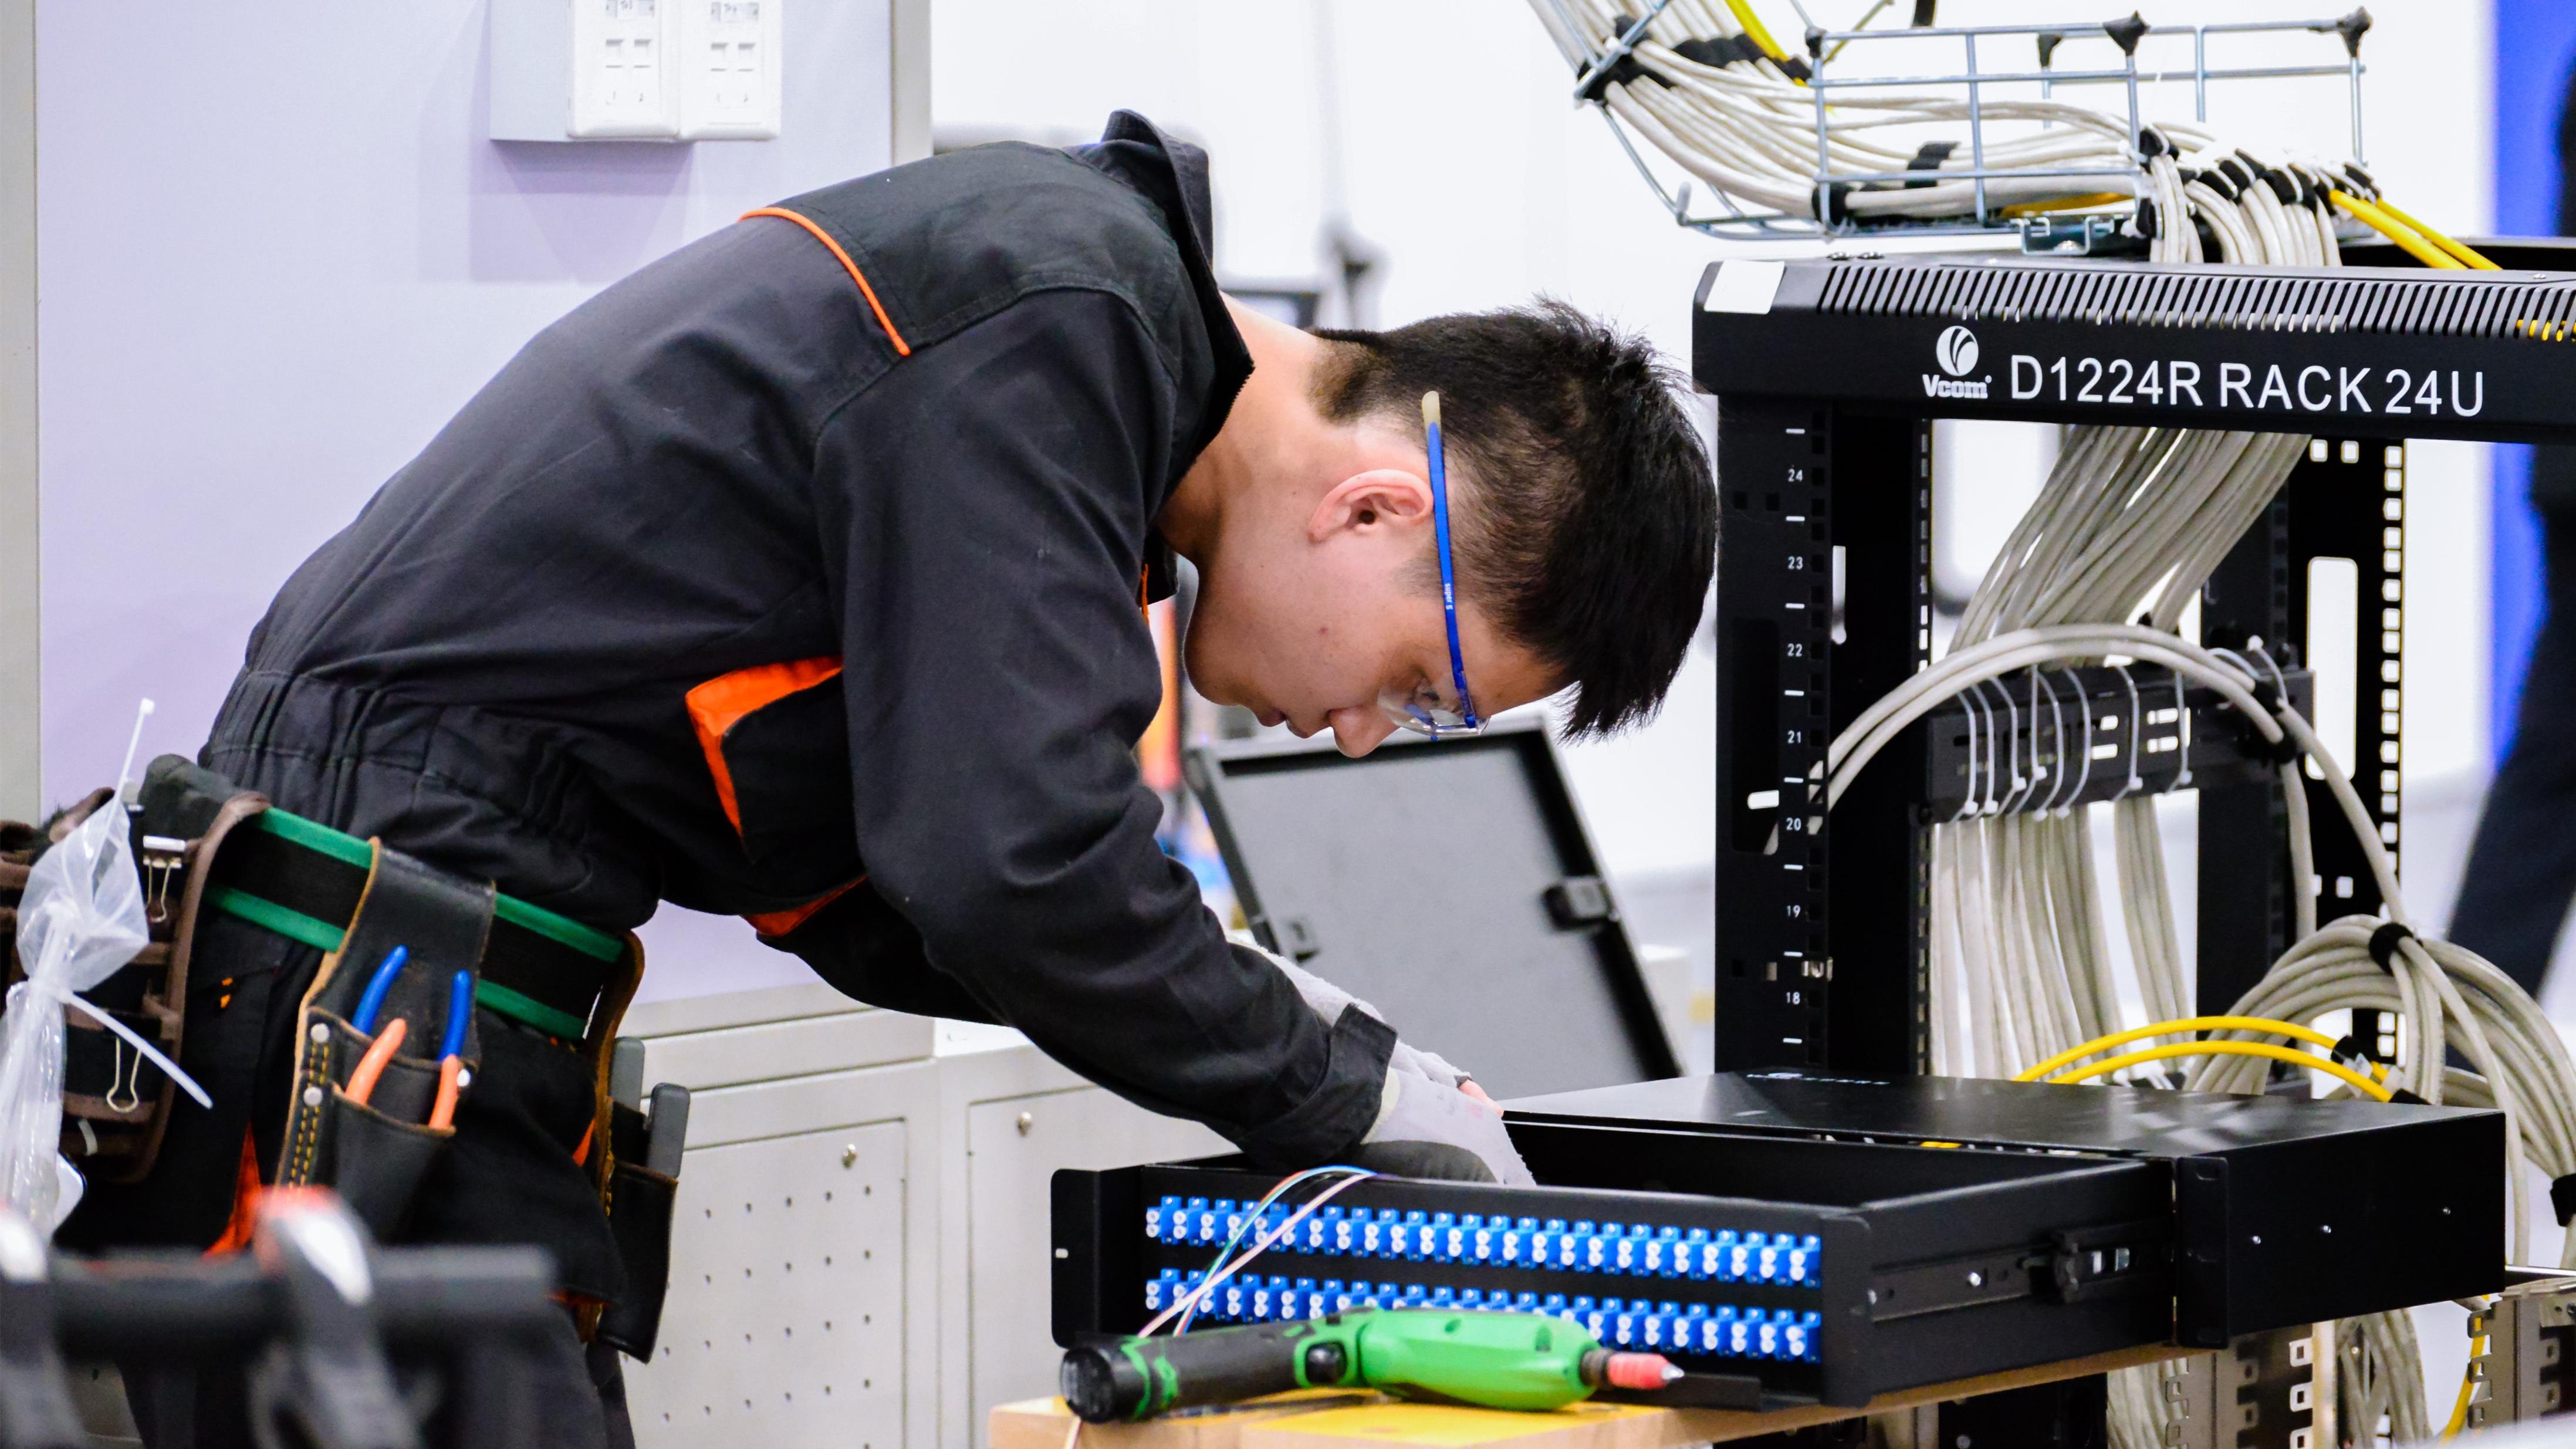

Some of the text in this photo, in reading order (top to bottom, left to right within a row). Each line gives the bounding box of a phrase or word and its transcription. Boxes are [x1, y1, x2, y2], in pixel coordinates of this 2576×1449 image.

[1922, 373, 1989, 399] Vcom
[2011, 354, 2203, 406] D1224R
[2220, 362, 2372, 413] RACK
[1788, 468, 1803, 482] 24
[1788, 556, 1803, 570] 23
[1787, 643, 1803, 657] 22
[1787, 730, 1801, 744] 21
[1786, 817, 1801, 831] 20
[1787, 905, 1801, 917] 19
[1786, 991, 1800, 1005] 18
